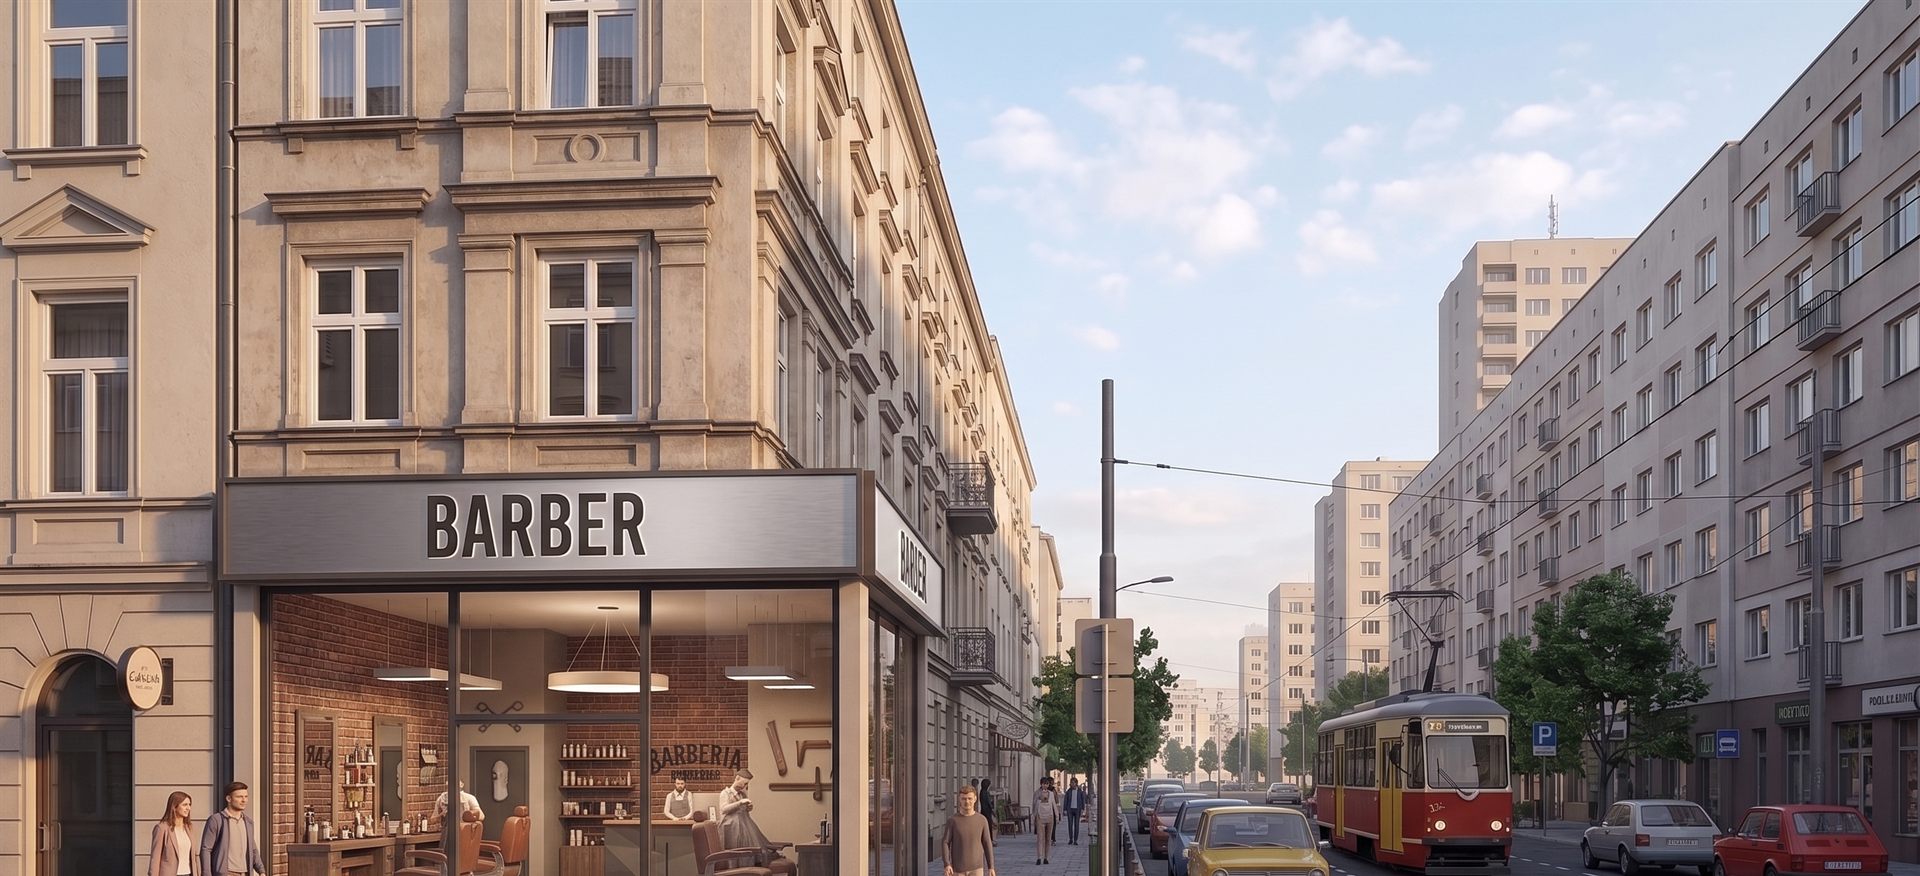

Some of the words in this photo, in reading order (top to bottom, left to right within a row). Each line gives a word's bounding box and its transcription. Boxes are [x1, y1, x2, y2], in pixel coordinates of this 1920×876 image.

[427, 492, 646, 558] BARBER
[1539, 726, 1552, 744] P
[650, 744, 740, 775] BARBERIA
